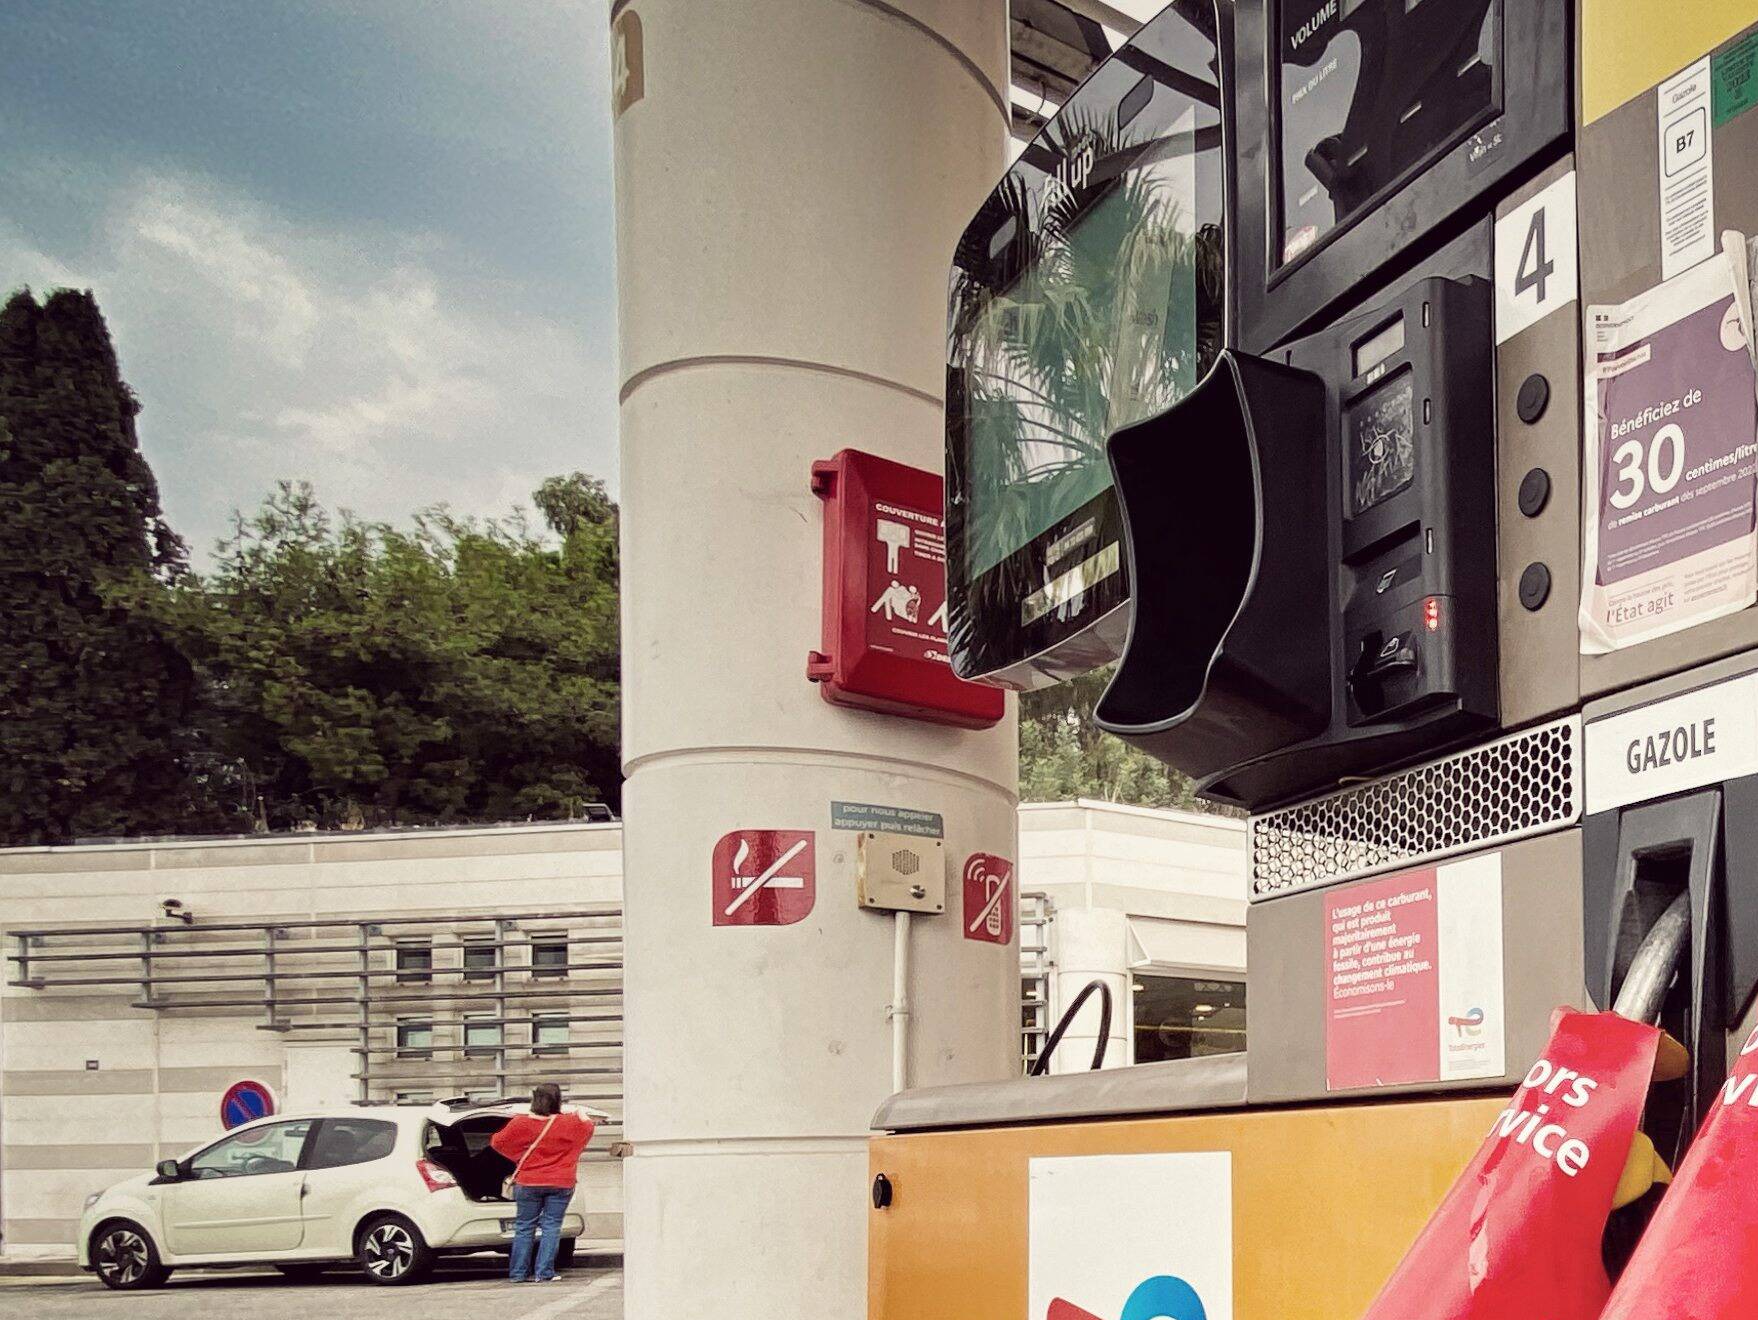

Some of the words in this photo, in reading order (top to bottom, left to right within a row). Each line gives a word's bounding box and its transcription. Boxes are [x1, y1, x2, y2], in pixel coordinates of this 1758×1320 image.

[1290, 0, 1337, 50] VOLUME
[1676, 130, 1695, 154] B7
[1515, 206, 1554, 304] 4
[1611, 400, 1679, 439] Bénéficiez
[1683, 389, 1701, 407] de
[1611, 424, 1684, 507] 30
[1618, 511, 1642, 525] remise
[1643, 495, 1679, 515] carburant
[1695, 473, 1736, 496] septembre
[875, 503, 940, 527] COUVERTURE
[1606, 603, 1643, 623] l'État
[1647, 592, 1673, 614] agit
[1626, 718, 1716, 774] GAZOLE
[843, 805, 868, 815] pour
[871, 807, 896, 817] nous
[1332, 905, 1361, 919] L'usage
[1362, 901, 1374, 912] de
[1375, 899, 1386, 909] ce
[1387, 888, 1431, 906] carburant,
[1332, 920, 1345, 933] qui
[1346, 918, 1359, 929] est
[1360, 910, 1390, 927] produit
[1332, 923, 1396, 944] majoritairement
[1332, 947, 1338, 958] à
[1339, 944, 1361, 959] partir
[1362, 940, 1386, 952] d'une
[1387, 932, 1420, 947] énergie
[1332, 957, 1360, 971] fossile,
[1361, 951, 1401, 966] contribue
[1403, 950, 1413, 959] au
[1333, 968, 1382, 985] changement
[1383, 960, 1431, 976] climatique.
[1333, 980, 1394, 998] Économisons-le
[1523, 1059, 1598, 1107] ors
[1487, 1104, 1590, 1177] vice
